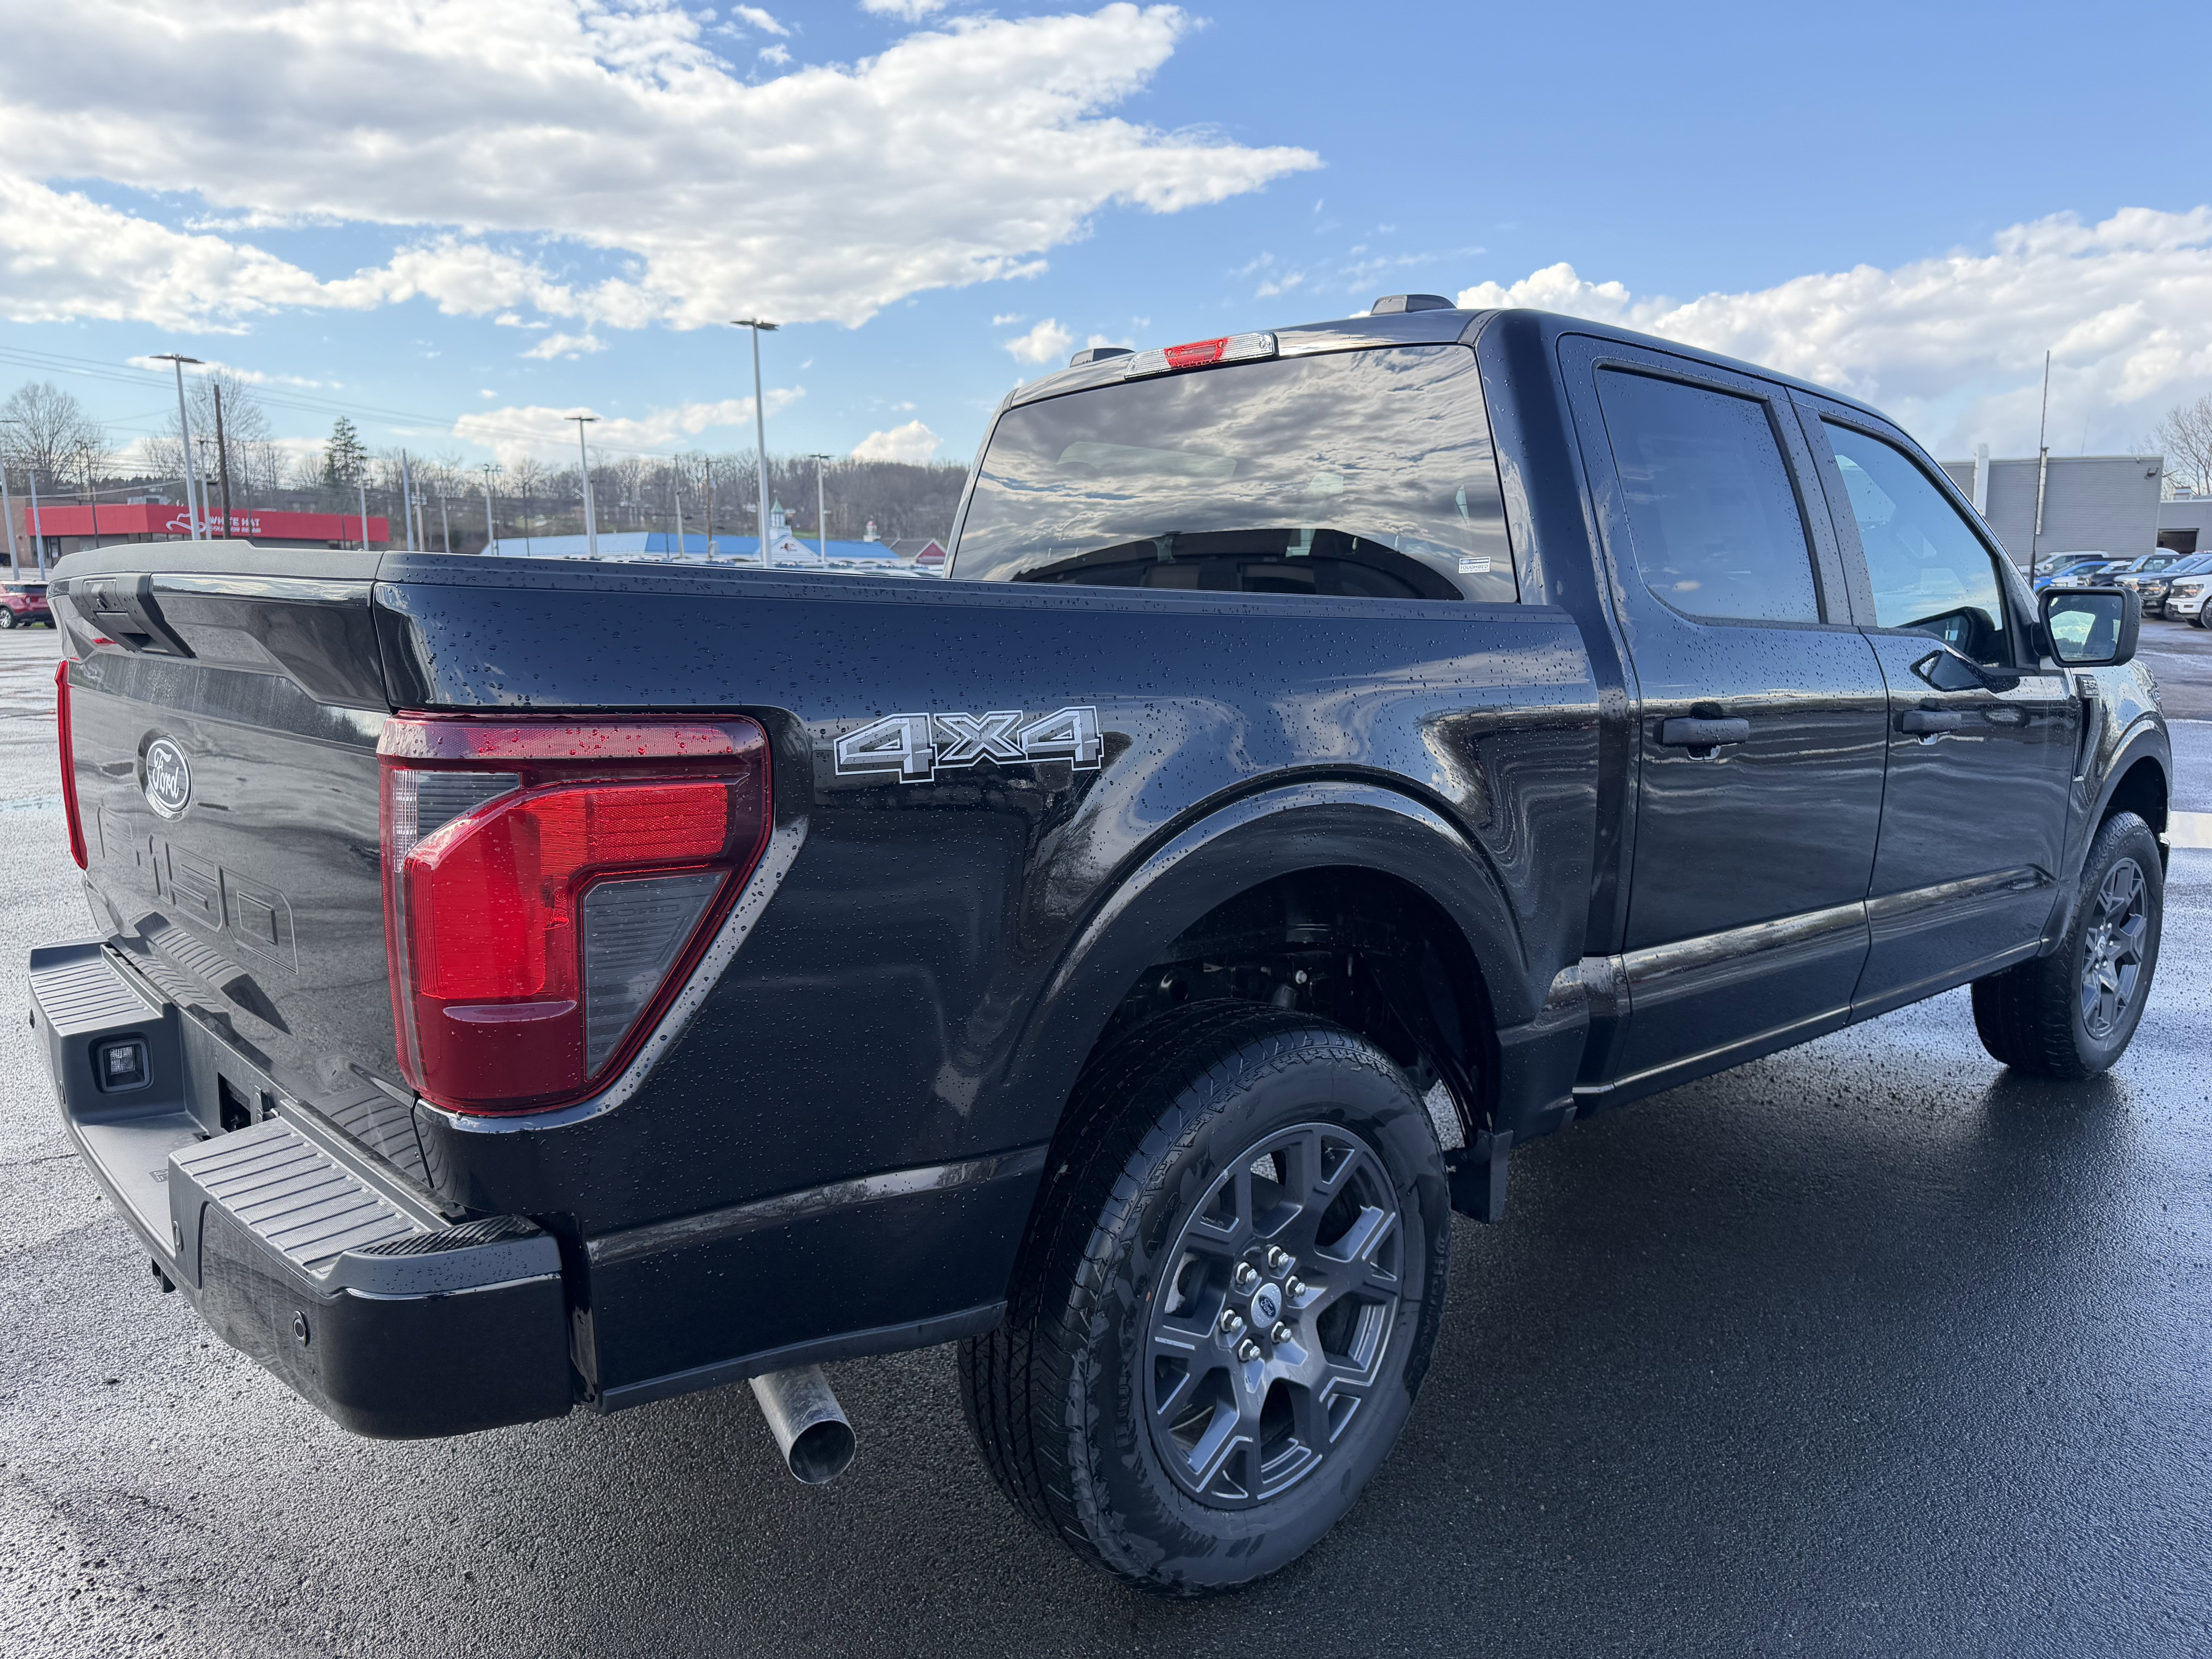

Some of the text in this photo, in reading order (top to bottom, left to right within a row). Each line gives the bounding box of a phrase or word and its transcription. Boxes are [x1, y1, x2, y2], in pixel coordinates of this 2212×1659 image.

[209, 516, 239, 526] WHE
[153, 748, 179, 799] Ford
[1260, 1298, 1274, 1316] Ford
